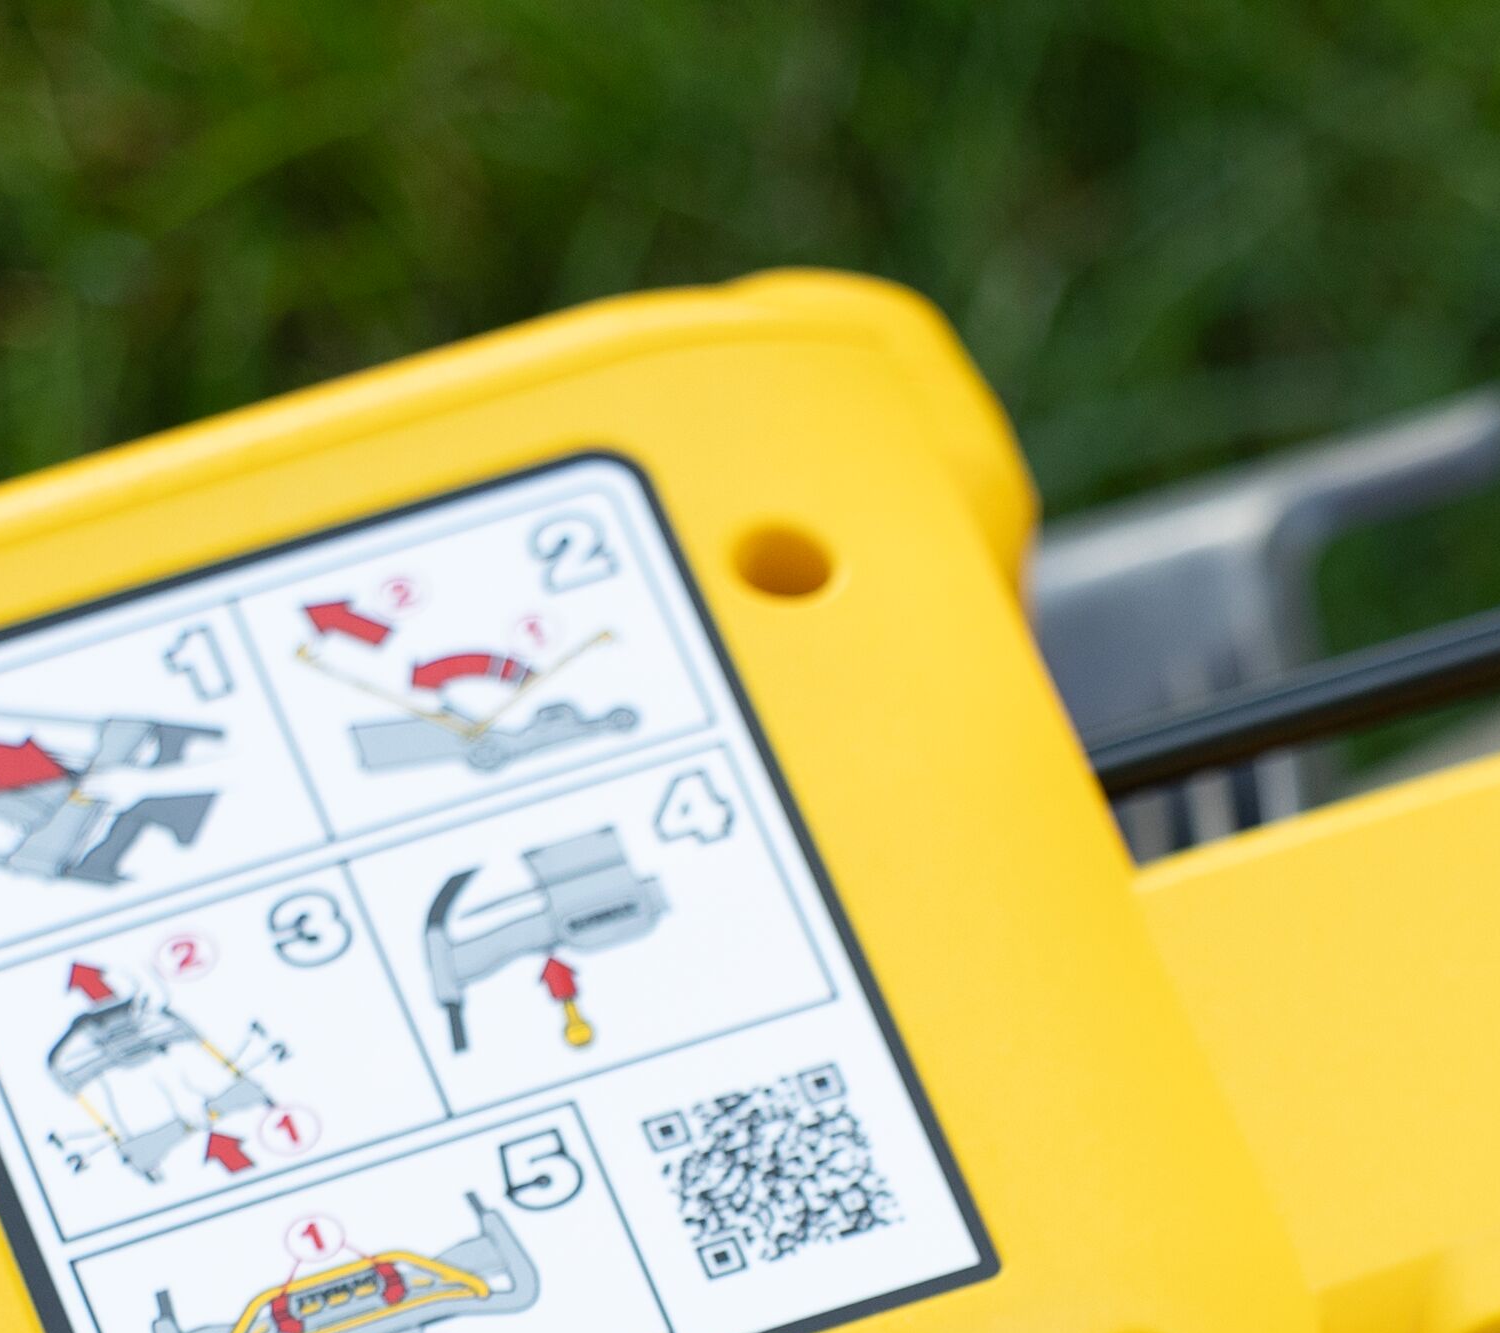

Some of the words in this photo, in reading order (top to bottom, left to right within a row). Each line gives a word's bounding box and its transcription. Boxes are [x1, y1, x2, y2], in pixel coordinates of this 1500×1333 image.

[525, 508, 621, 594] 2
[162, 623, 236, 702] 1
[653, 768, 736, 845] 4
[267, 888, 354, 968] 3
[498, 1128, 584, 1212] 5
